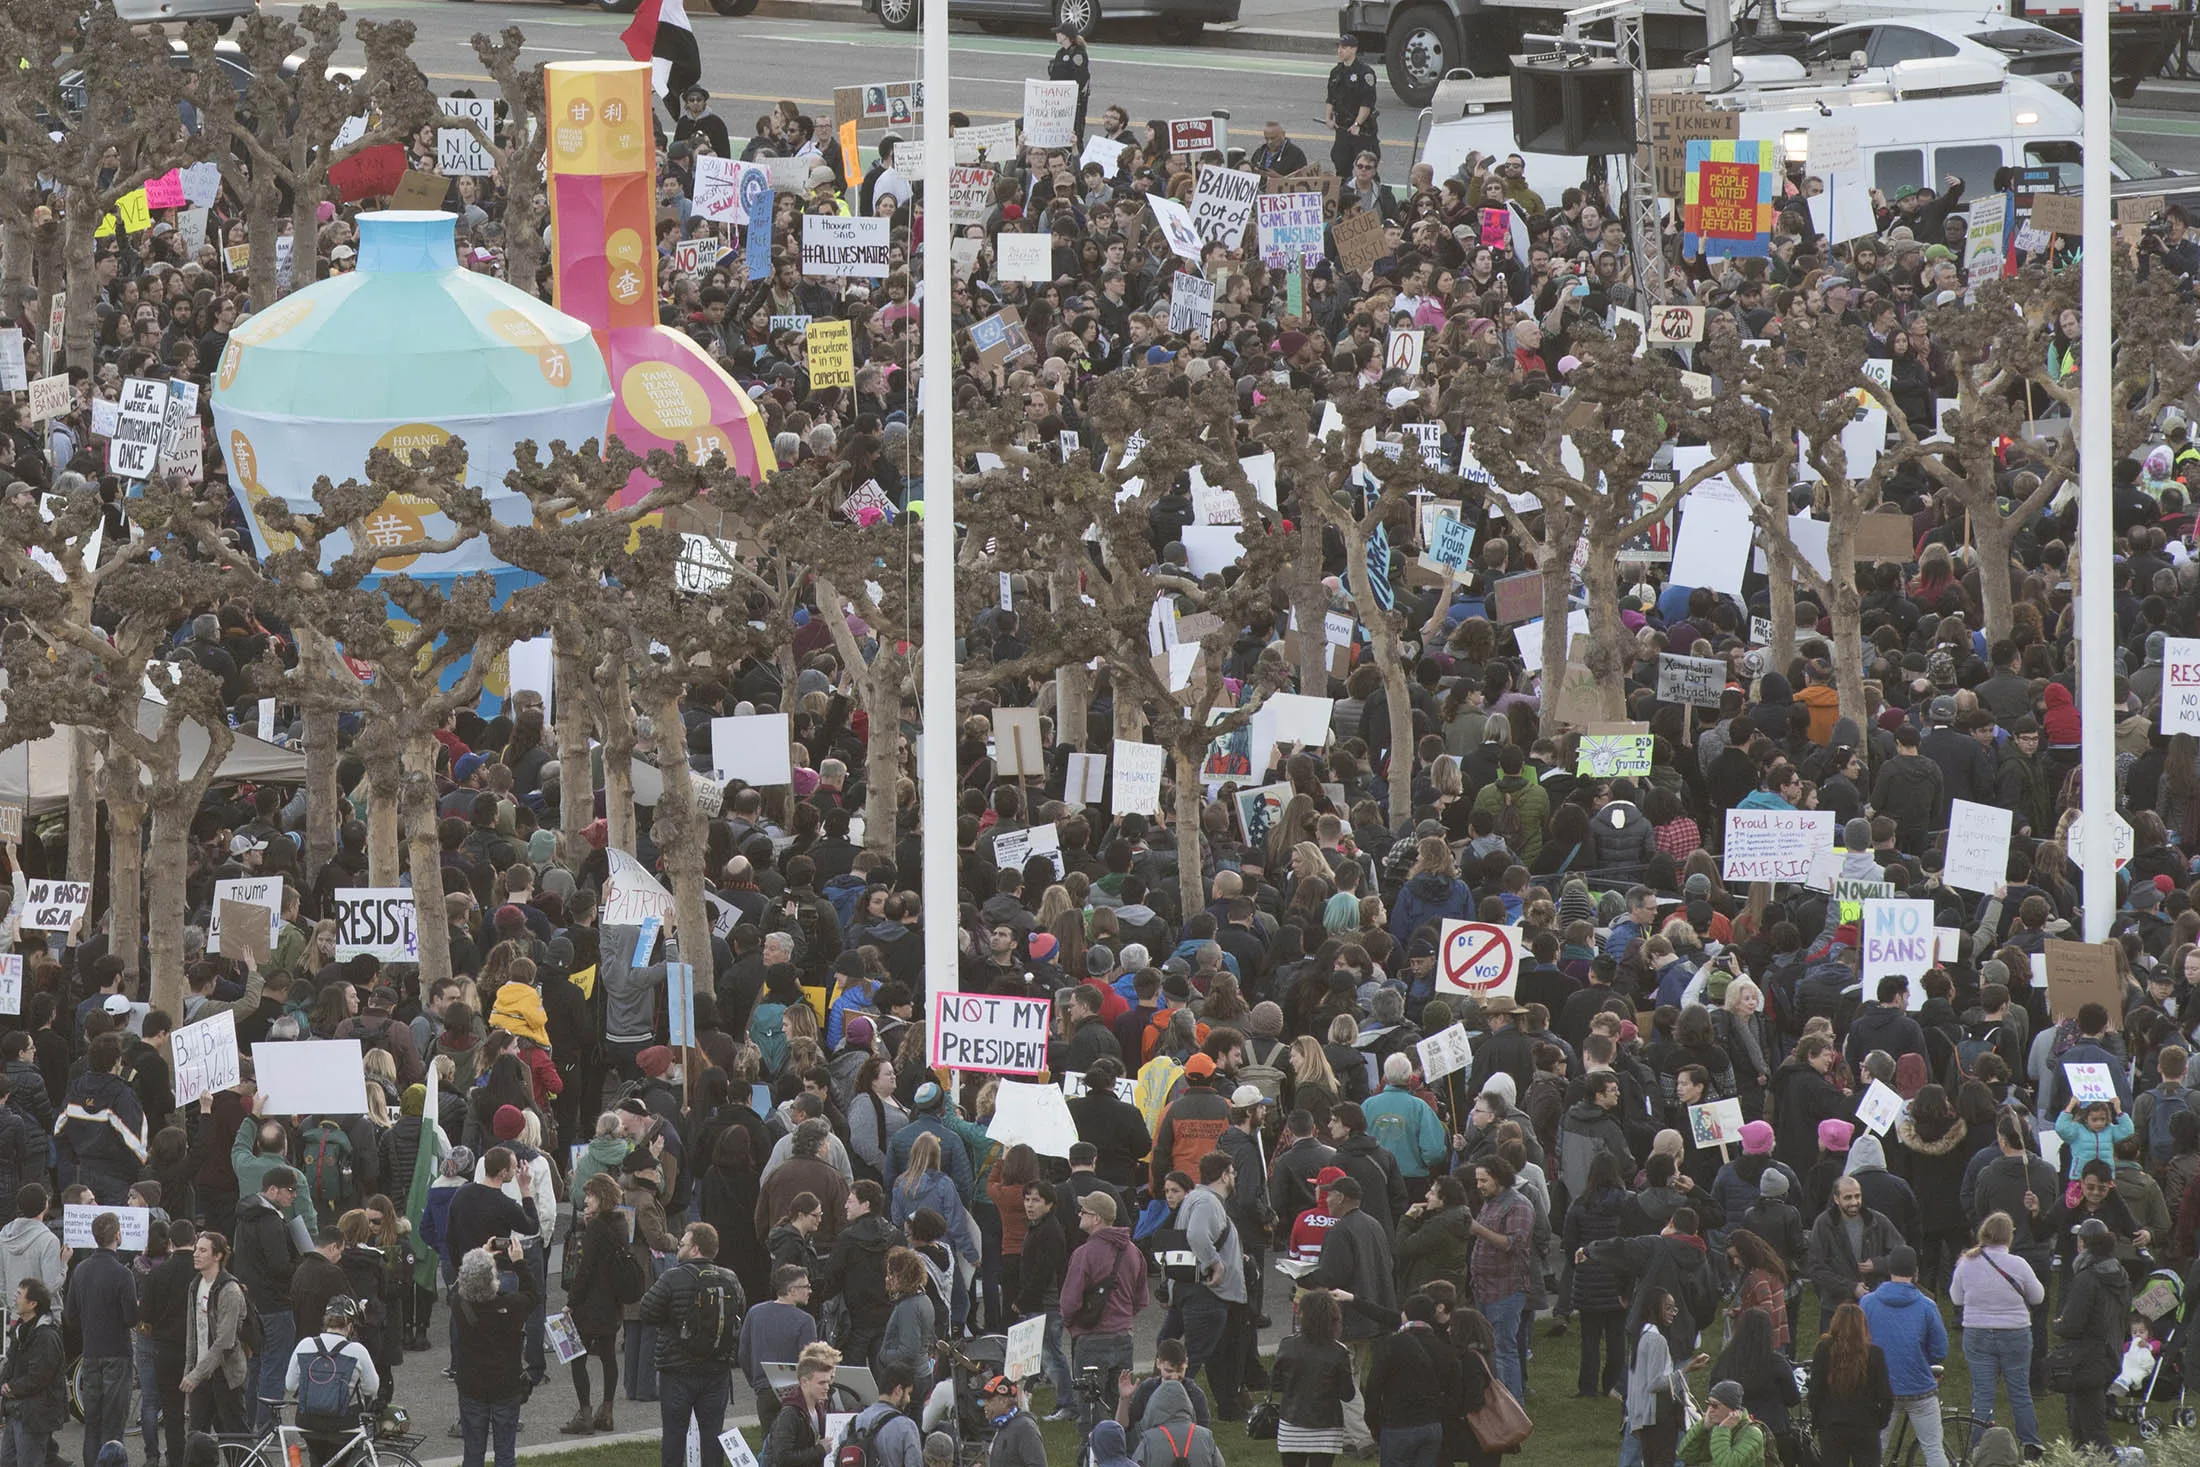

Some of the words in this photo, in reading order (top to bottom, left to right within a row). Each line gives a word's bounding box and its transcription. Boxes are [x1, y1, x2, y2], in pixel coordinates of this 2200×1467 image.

[445, 102, 483, 117] NO
[571, 104, 589, 121] 甘
[1682, 117, 1721, 130] KNEW
[446, 138, 483, 154] NO
[441, 155, 489, 173] WALL
[1720, 166, 1739, 175] THE
[950, 169, 994, 187] USLIMS
[1198, 168, 1257, 204] BANNON
[1709, 174, 1749, 187] PEOPLE
[950, 189, 988, 203] LIDARITY
[1710, 186, 1746, 199] UNITED
[1259, 196, 1295, 213] FIRST
[1715, 199, 1741, 208] WILL
[1304, 209, 1321, 225] THE
[1702, 207, 1735, 219] NEVER
[1739, 208, 1753, 219] BE
[1333, 217, 1375, 244] RESCUE
[1700, 219, 1753, 232] DEFEATED
[1273, 226, 1321, 245] MUSLIMS
[676, 247, 698, 272] NO
[699, 239, 716, 252] BAN
[698, 252, 717, 265] HATE
[808, 328, 818, 340] all
[810, 343, 823, 354] are
[546, 348, 564, 379] 方
[640, 369, 674, 382] YANG
[34, 384, 53, 399] BAN
[134, 382, 154, 401] WE
[35, 391, 69, 415] BANNON
[124, 399, 145, 413] WERE
[144, 402, 160, 414] ALL
[113, 411, 162, 447] IMMIGRANTS
[181, 425, 199, 441] GHT
[393, 434, 440, 447] HOANG
[118, 445, 147, 471] ONCE
[175, 449, 199, 462] CISM
[1445, 522, 1468, 541] LIFT
[1440, 538, 1465, 556] YOUR
[1436, 550, 1462, 569] LAMP
[1664, 657, 1713, 681] Xenophobia
[1733, 815, 1768, 830] Proud
[1800, 816, 1817, 829] be
[1964, 847, 1990, 859] NOT
[1727, 859, 1811, 879] AMERIC
[29, 884, 49, 904] NO
[230, 884, 269, 901] TRUMP
[607, 887, 674, 921] PATRIO
[36, 907, 73, 926] USA
[335, 899, 417, 945] RESIST
[1875, 907, 1920, 937] NO
[1458, 936, 1473, 947] DE
[1868, 937, 1927, 964] BANS
[1474, 964, 1499, 978] VOS
[943, 998, 1000, 1024] NOT
[1013, 1002, 1048, 1029] MY
[942, 1032, 1047, 1069] PRESIDENT
[177, 1071, 202, 1099] Not
[204, 1055, 235, 1091] Walls
